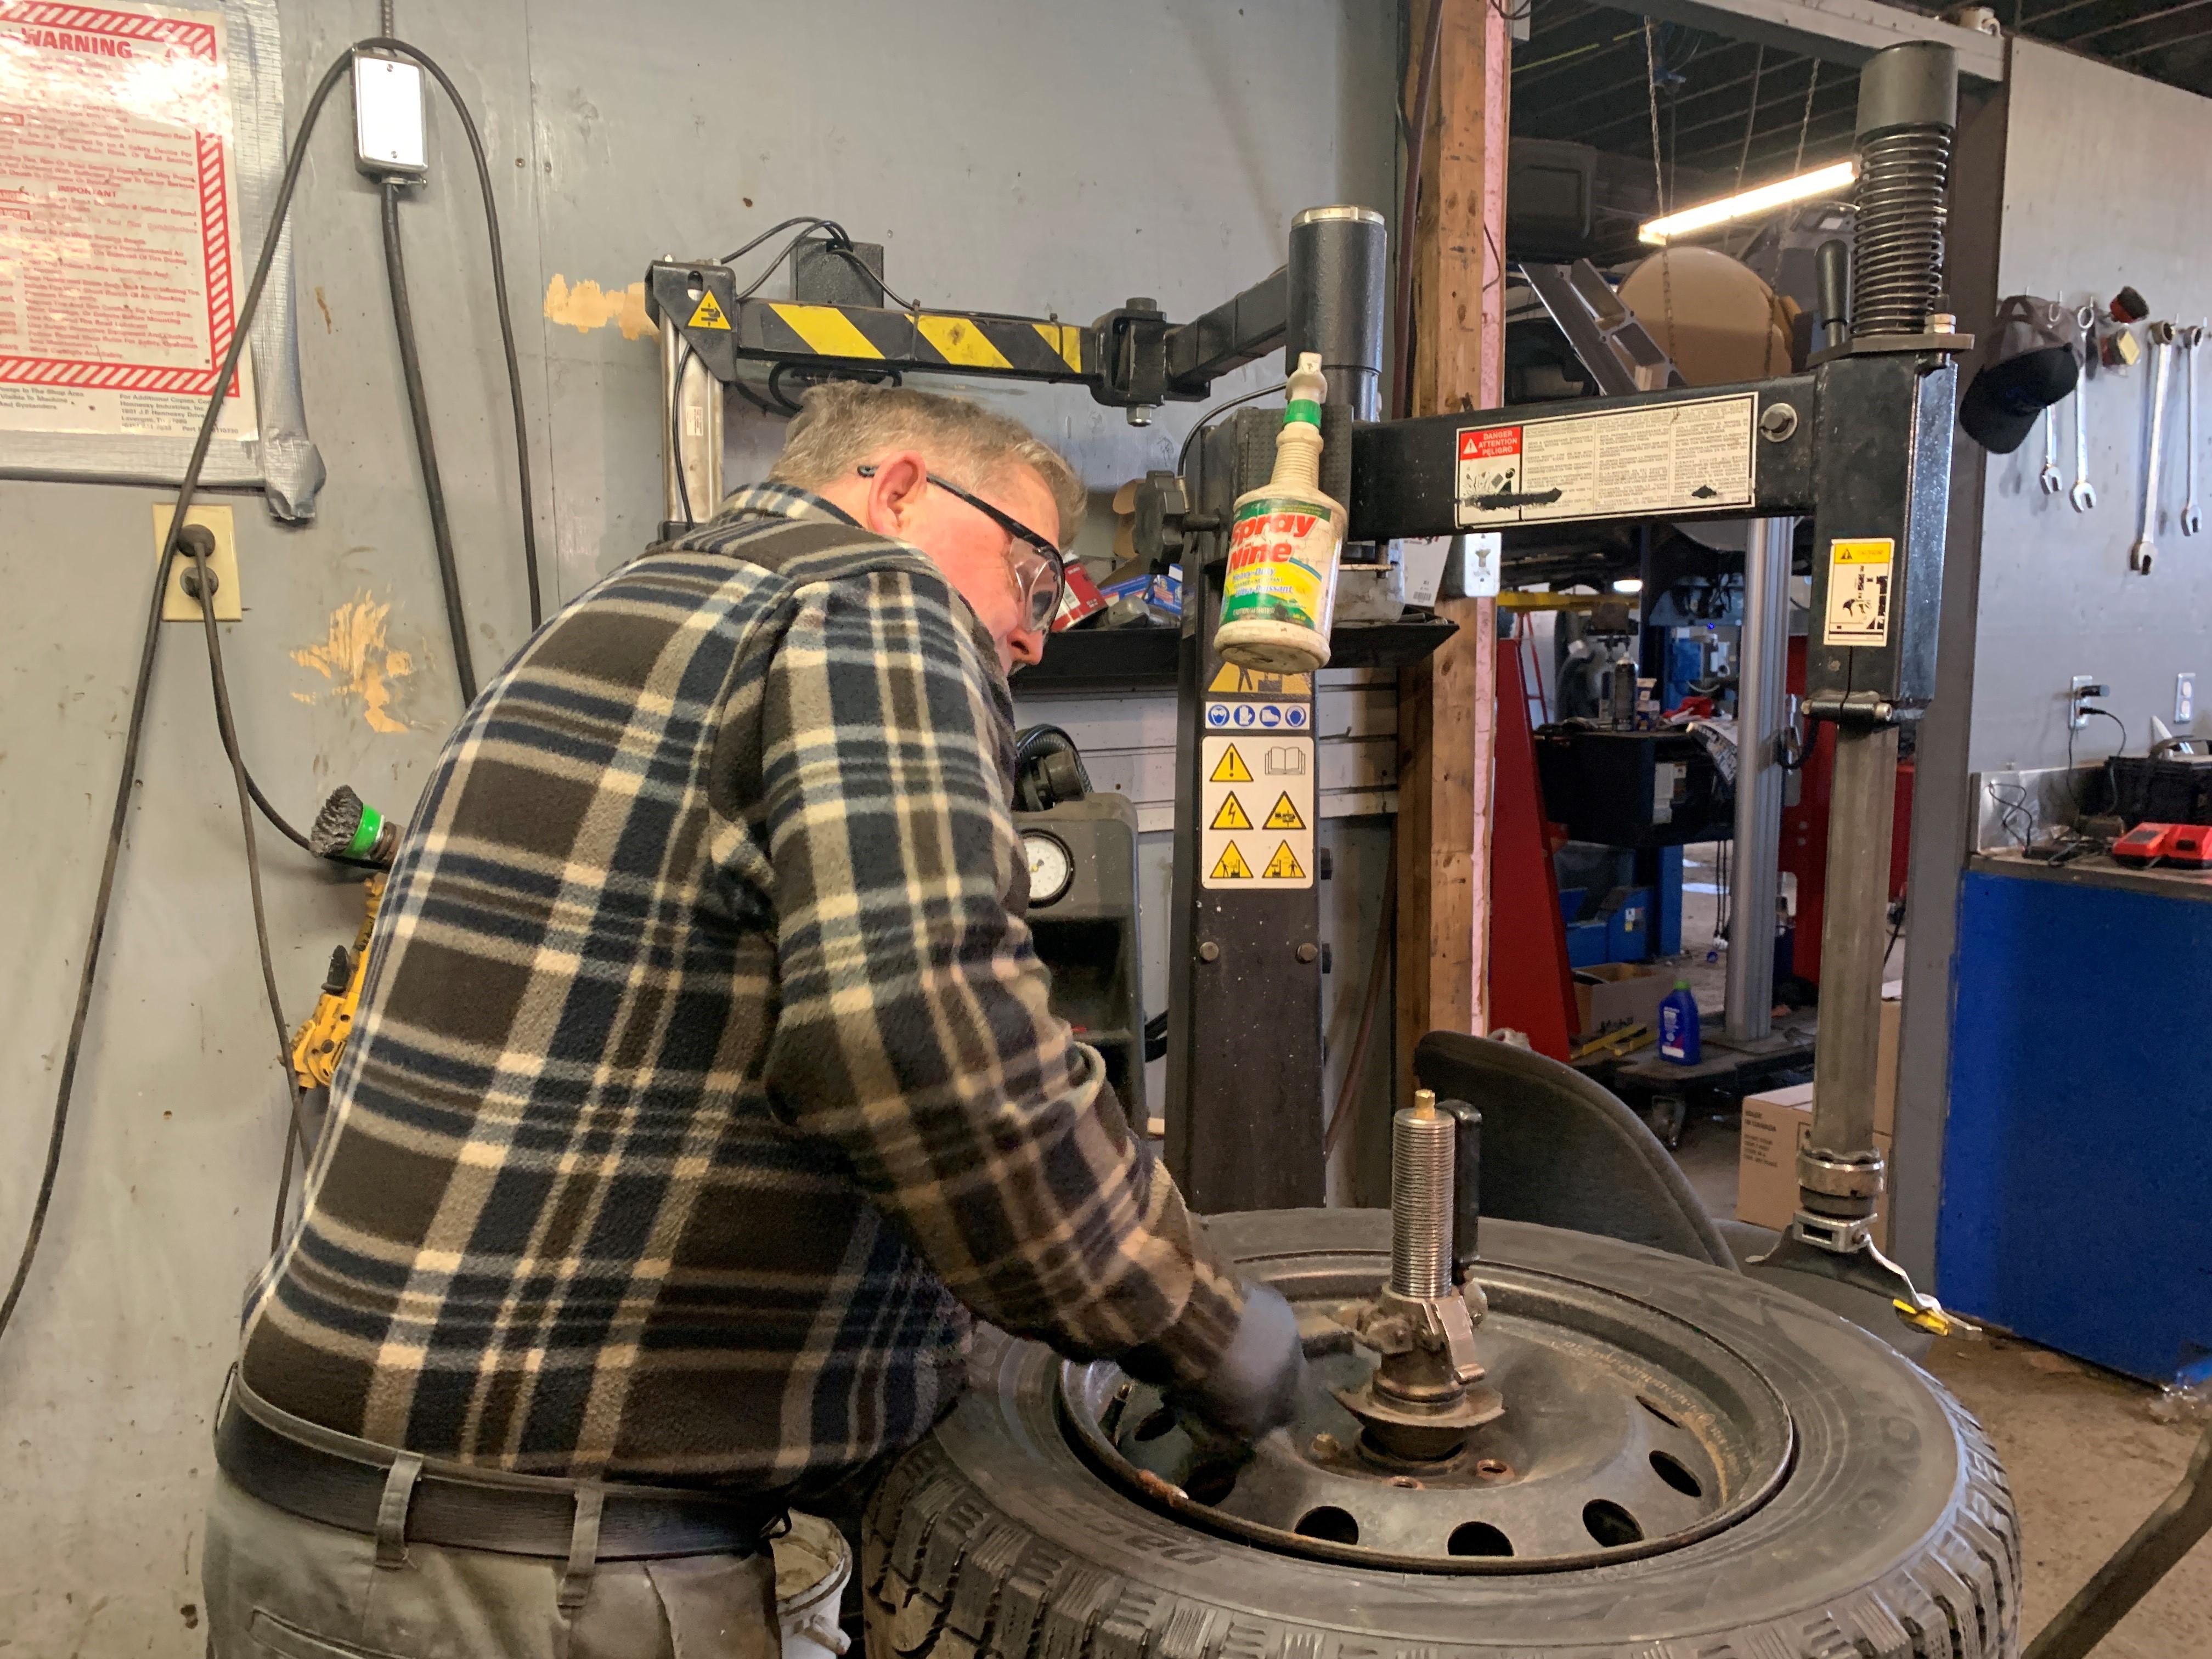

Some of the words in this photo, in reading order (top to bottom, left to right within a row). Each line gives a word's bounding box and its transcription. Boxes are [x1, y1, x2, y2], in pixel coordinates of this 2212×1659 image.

[21, 27, 133, 59] WARNING
[1478, 437, 1517, 449] ATTENTION
[1483, 430, 1513, 440] DANGER
[1482, 445, 1513, 456] PELIGRO
[1231, 513, 1317, 548] Spray
[1228, 542, 1292, 573] Nine
